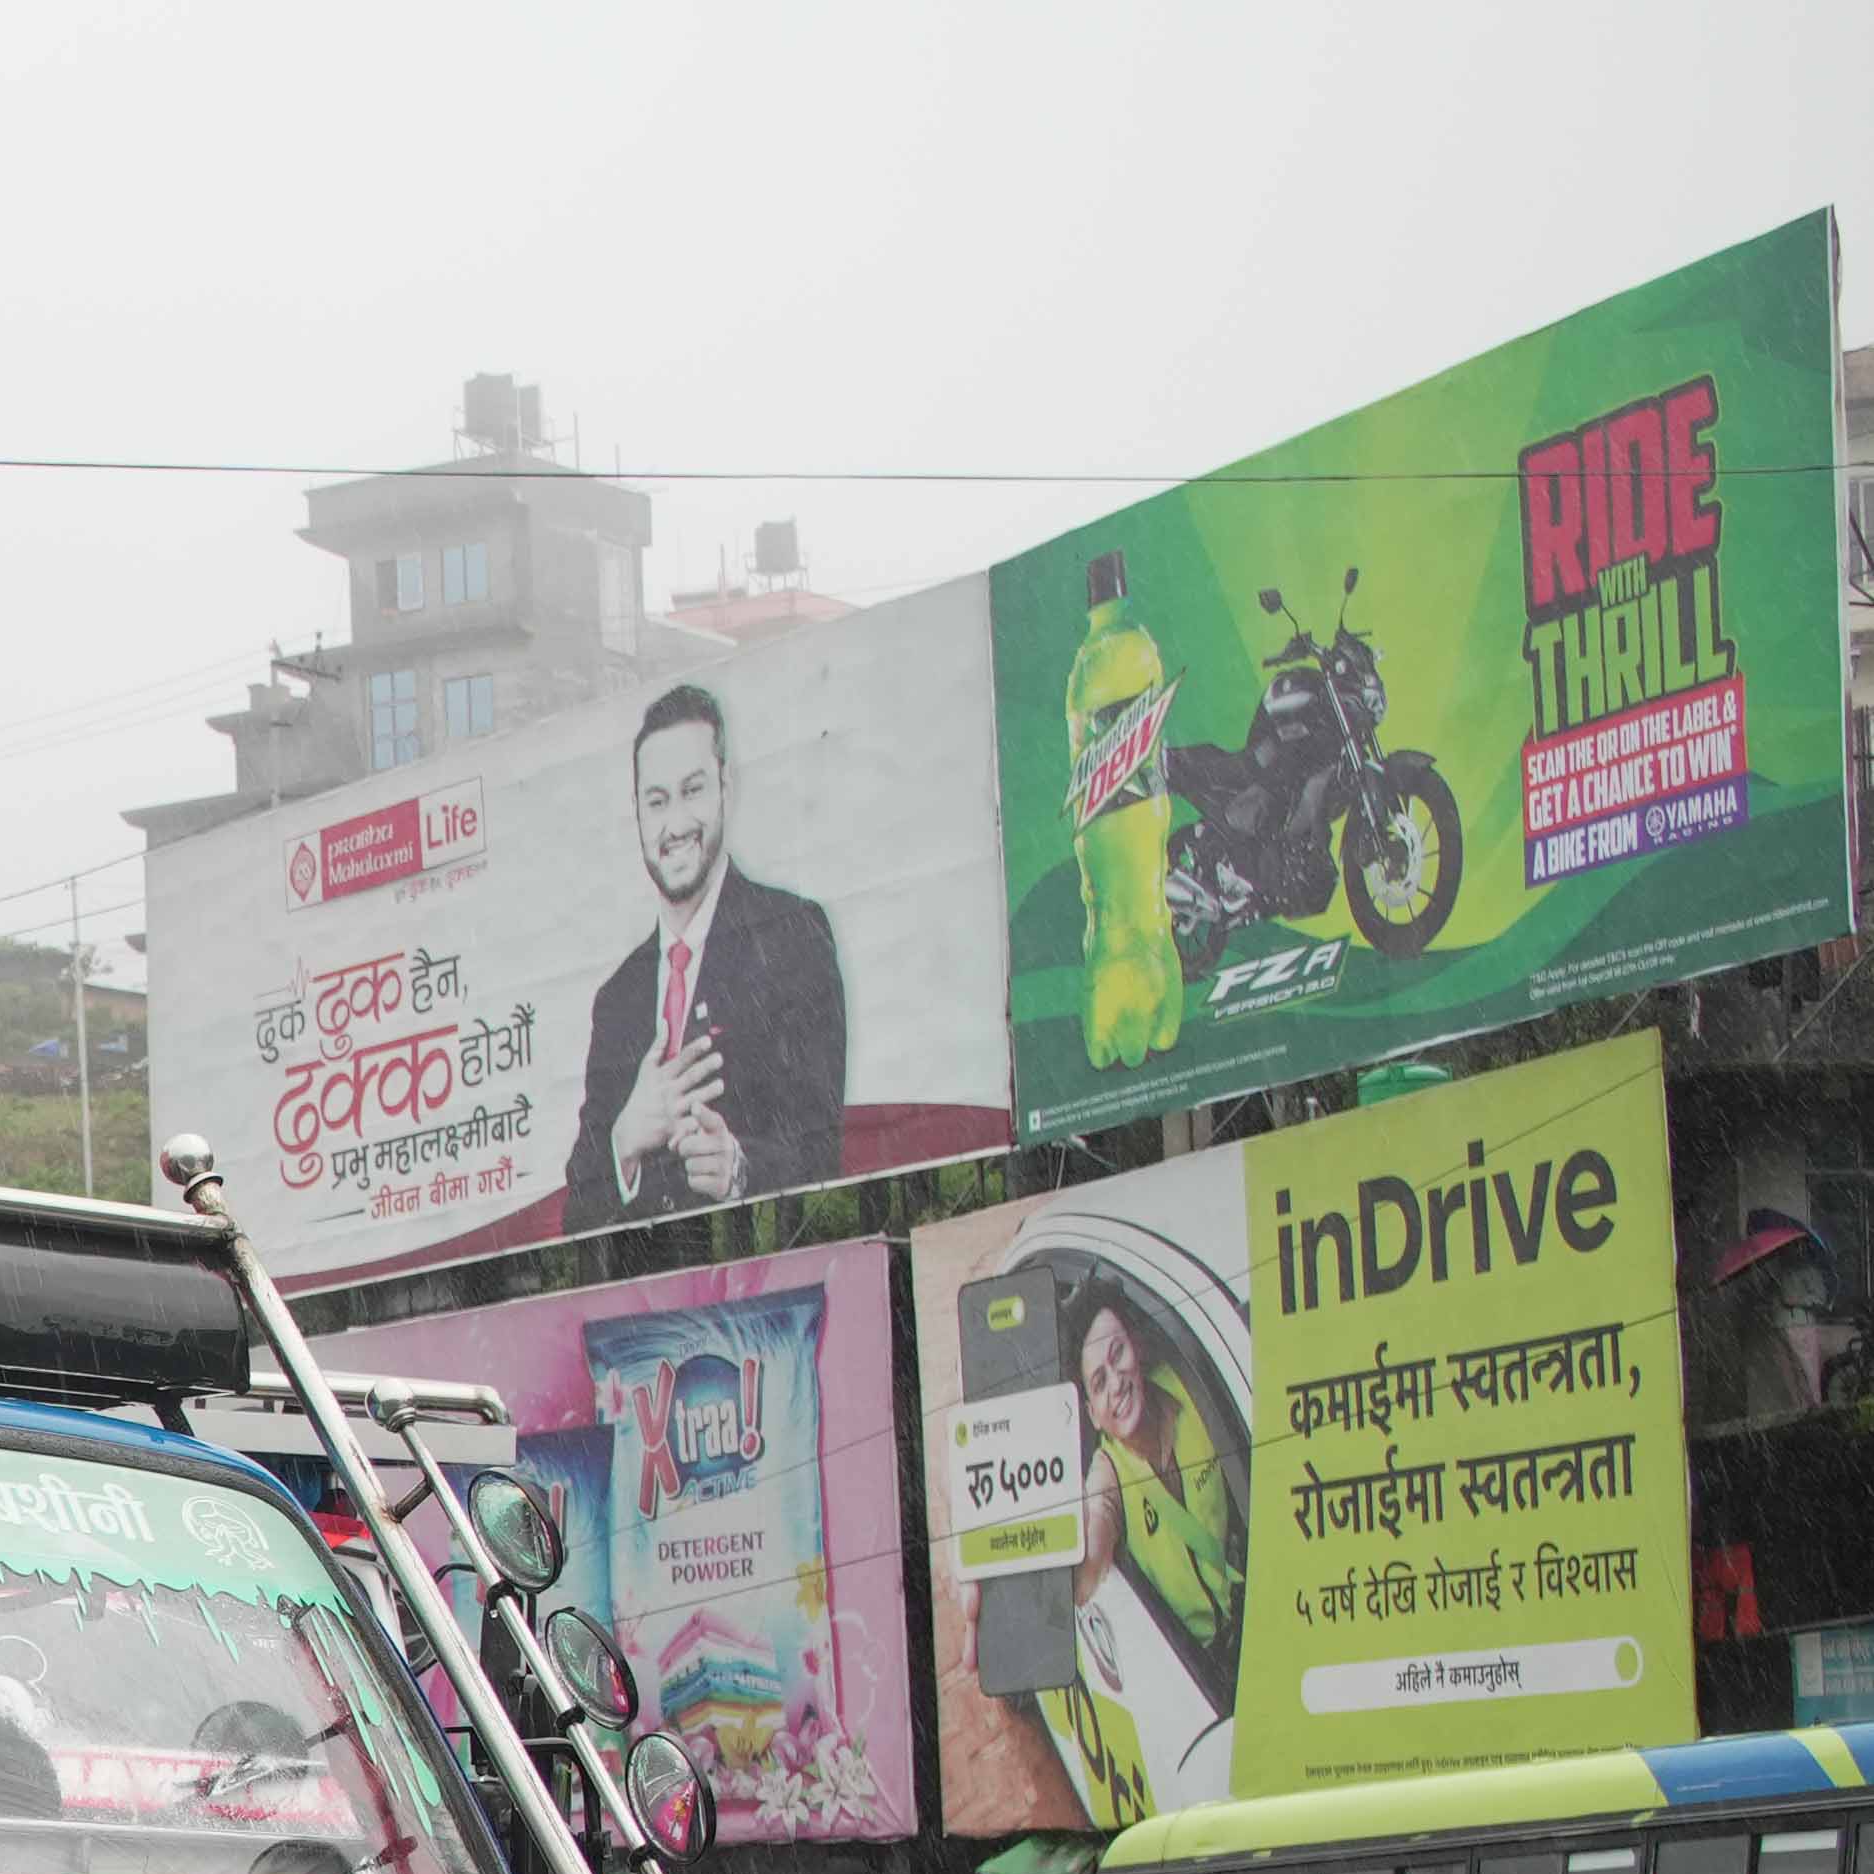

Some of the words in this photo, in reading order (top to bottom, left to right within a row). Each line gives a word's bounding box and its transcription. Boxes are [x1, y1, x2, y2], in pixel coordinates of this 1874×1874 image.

[1523, 382, 1719, 608] RIDE
[1597, 550, 1650, 609] WITH
[1530, 562, 1729, 737] THRILL
[1528, 745, 1566, 786] SCAN
[1567, 736, 1594, 773] THE
[1620, 721, 1640, 755] ON
[1642, 710, 1670, 748] THE
[1673, 694, 1721, 739] LABEL
[1723, 689, 1737, 723] &
[426, 803, 478, 849] Life
[1528, 783, 1564, 831] GET
[1567, 778, 1581, 820] A
[1583, 752, 1655, 814] CHANCE
[1657, 744, 1685, 790] TO
[1532, 841, 1546, 881] A
[1547, 829, 1586, 876] BIKE
[1587, 811, 1638, 863] FROM
[1665, 785, 1738, 829] YAMAHA
[1206, 946, 1309, 1003] FZ
[370, 1184, 421, 1220] जीवन
[429, 1171, 469, 1207] बीमा
[1275, 1138, 1618, 1316] inDrive
[1286, 1341, 1436, 1439] कमाईमा
[999, 1455, 1065, 1503] ५०००
[1291, 1445, 1446, 1541] रोजाईमा
[1456, 1433, 1636, 1518] स्वतन्त्रता
[657, 1530, 765, 1562] DETERGENT
[671, 1557, 754, 1585] POWDER
[1320, 1567, 1357, 1624] वर्ष
[1364, 1562, 1417, 1621] देखि
[1425, 1548, 1501, 1611] रोजाई
[1510, 1562, 1526, 1601] र
[1534, 1542, 1638, 1600] विश्वास
[1396, 1662, 1433, 1693] अहिले
[1435, 1657, 1445, 1688] नै
